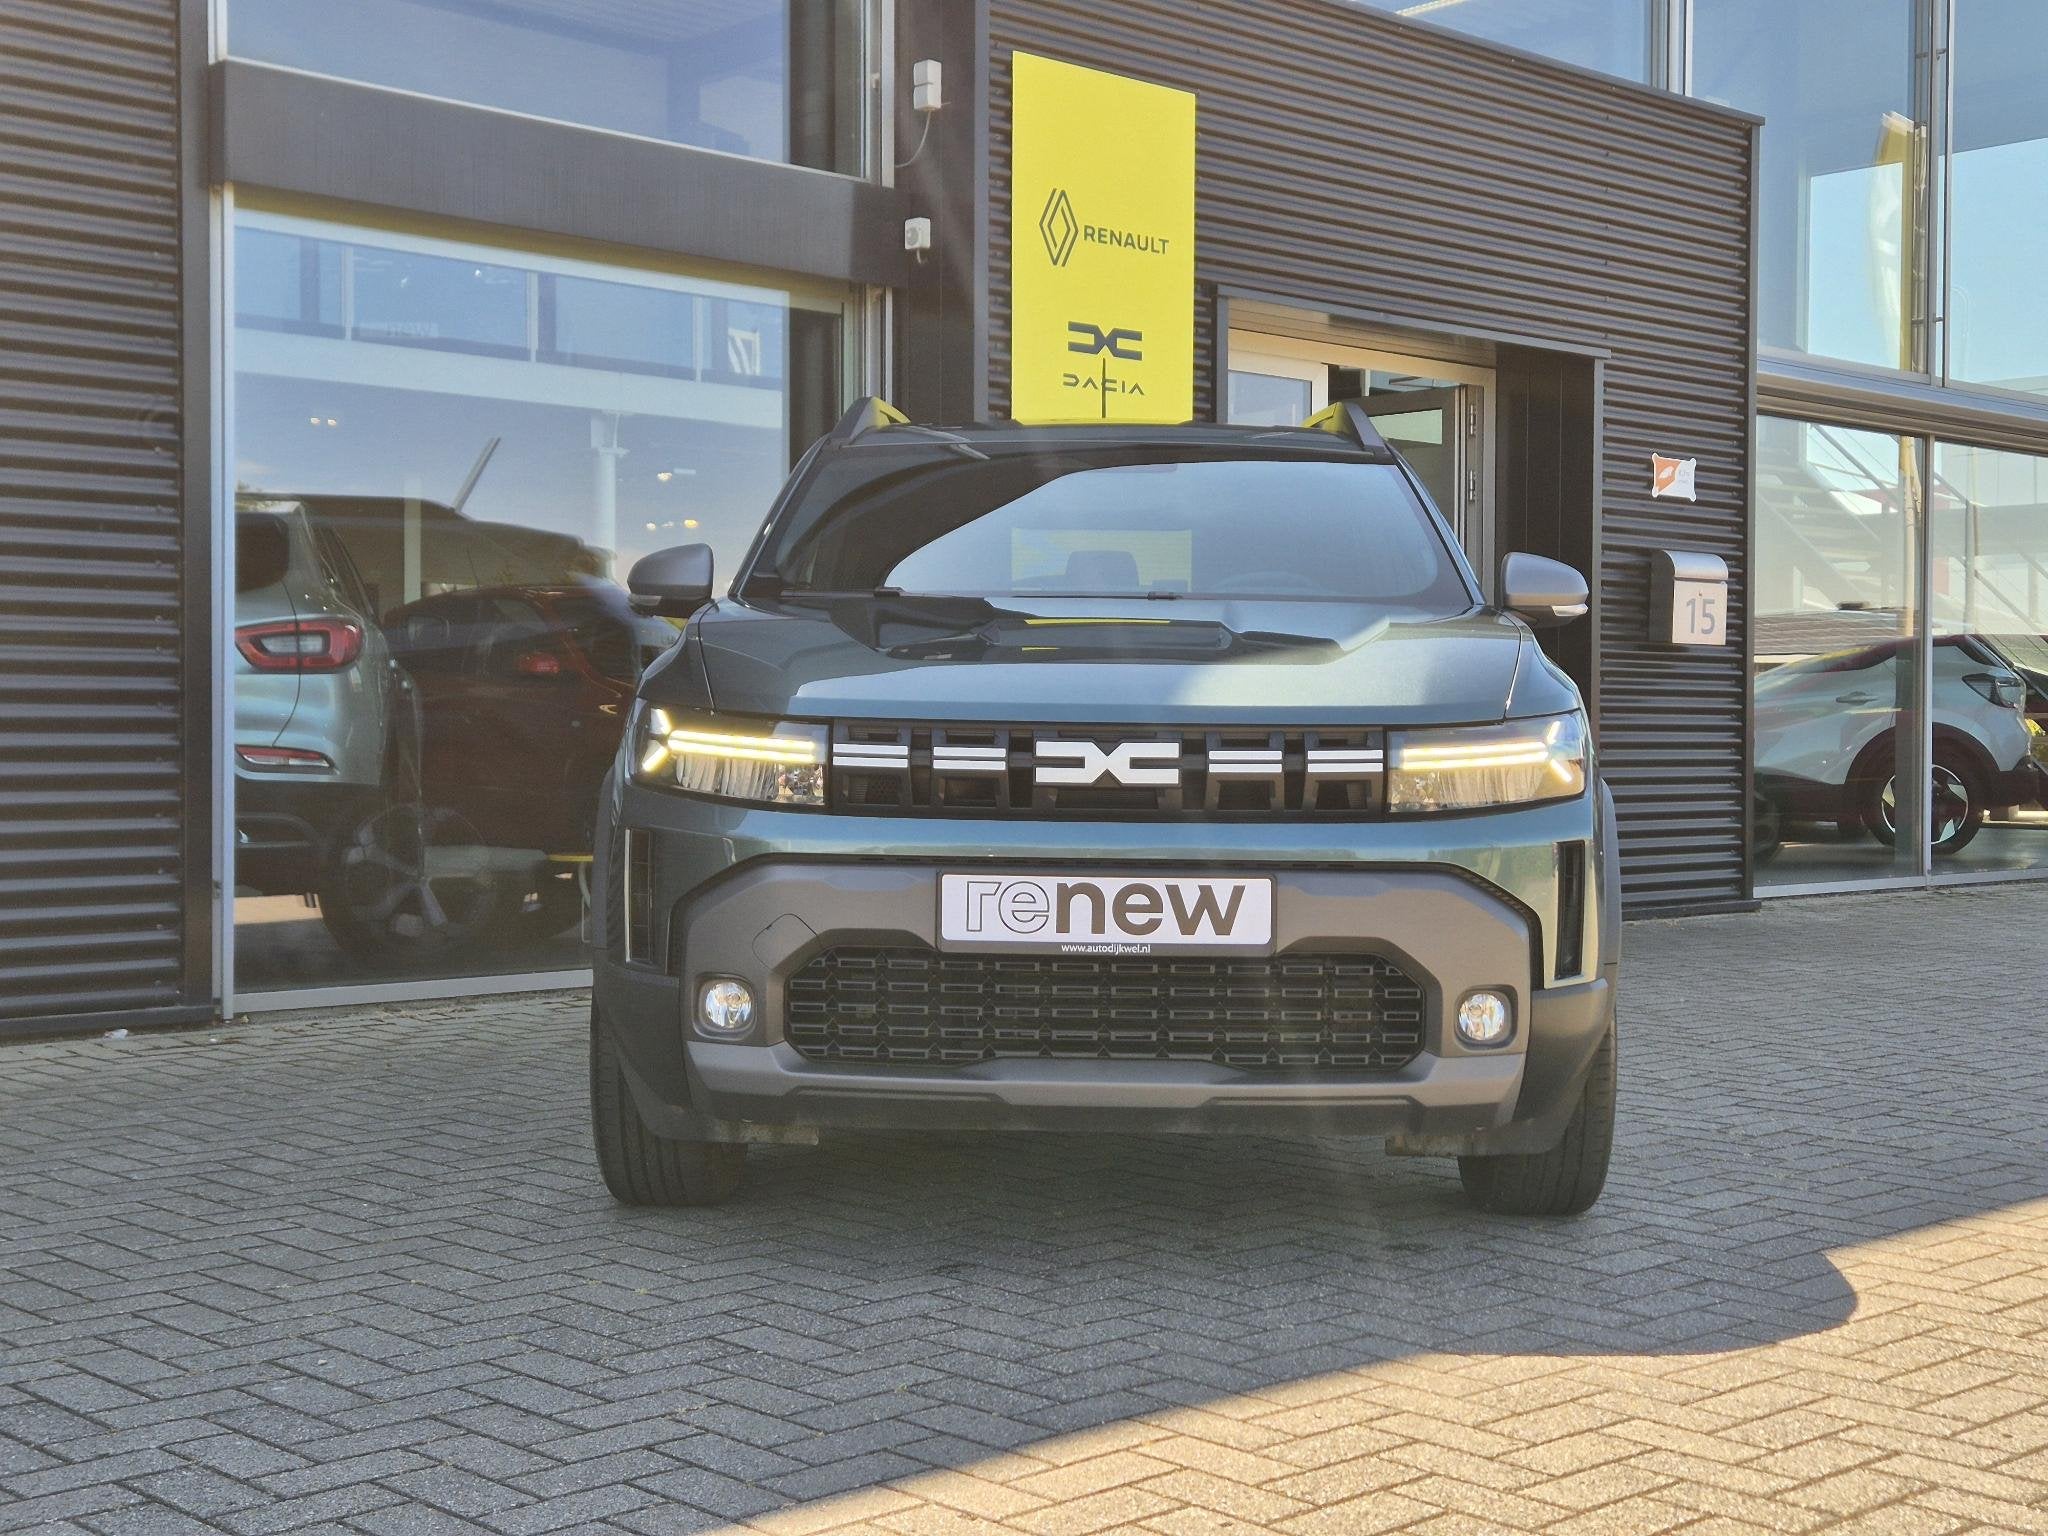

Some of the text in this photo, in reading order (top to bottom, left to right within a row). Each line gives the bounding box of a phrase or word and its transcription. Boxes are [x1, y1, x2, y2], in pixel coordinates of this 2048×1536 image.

[1083, 225, 1169, 254] RENAULT
[1062, 372, 1145, 396] DACIA
[1686, 597, 1716, 635] 15
[966, 881, 1246, 936] renew
[1061, 943, 1151, 955] www.autodijkwel.nl
